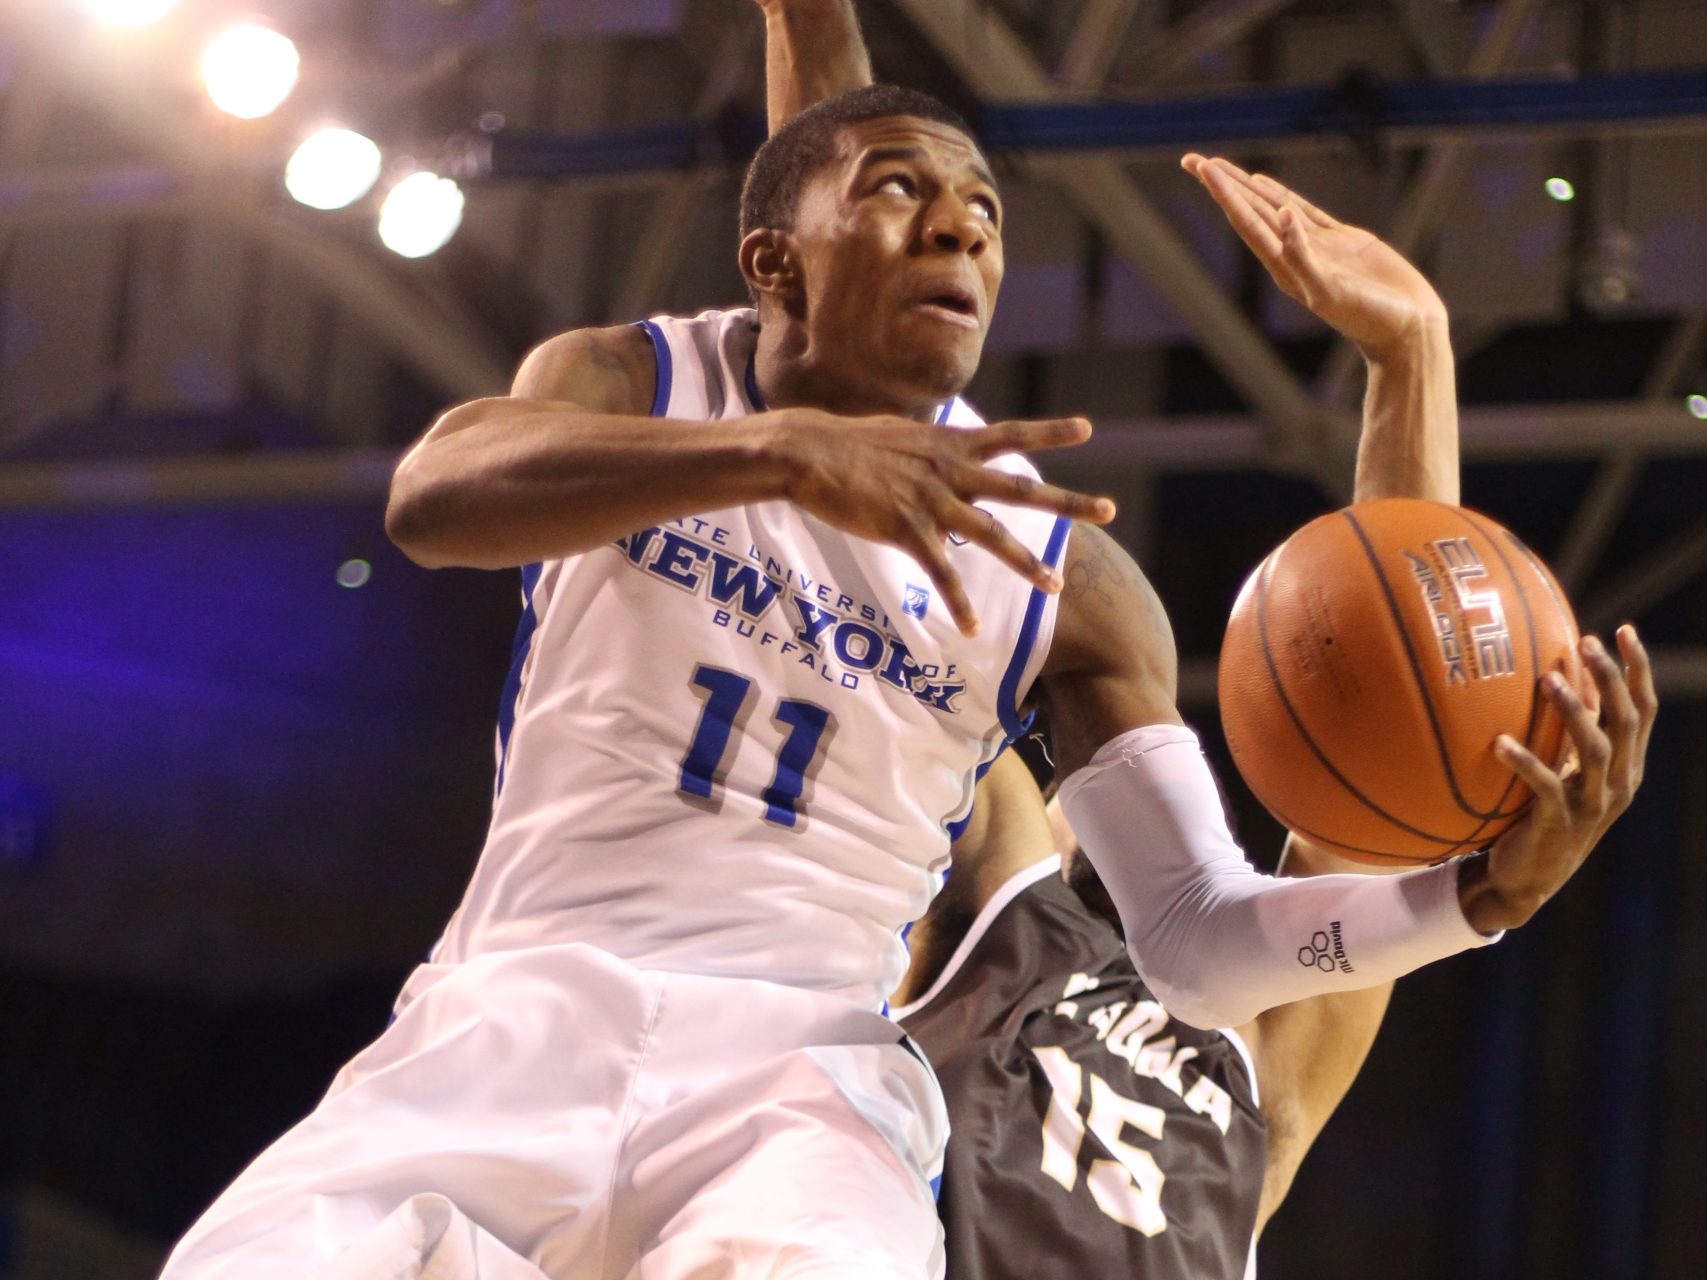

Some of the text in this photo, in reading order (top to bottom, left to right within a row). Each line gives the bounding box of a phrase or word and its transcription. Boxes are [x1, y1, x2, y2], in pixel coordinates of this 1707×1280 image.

[611, 526, 965, 715] NEW YORK
[712, 609, 860, 691] BUFFALO
[920, 664, 957, 679] OF
[678, 663, 837, 832] 11
[1031, 1046, 1167, 1238] 15
